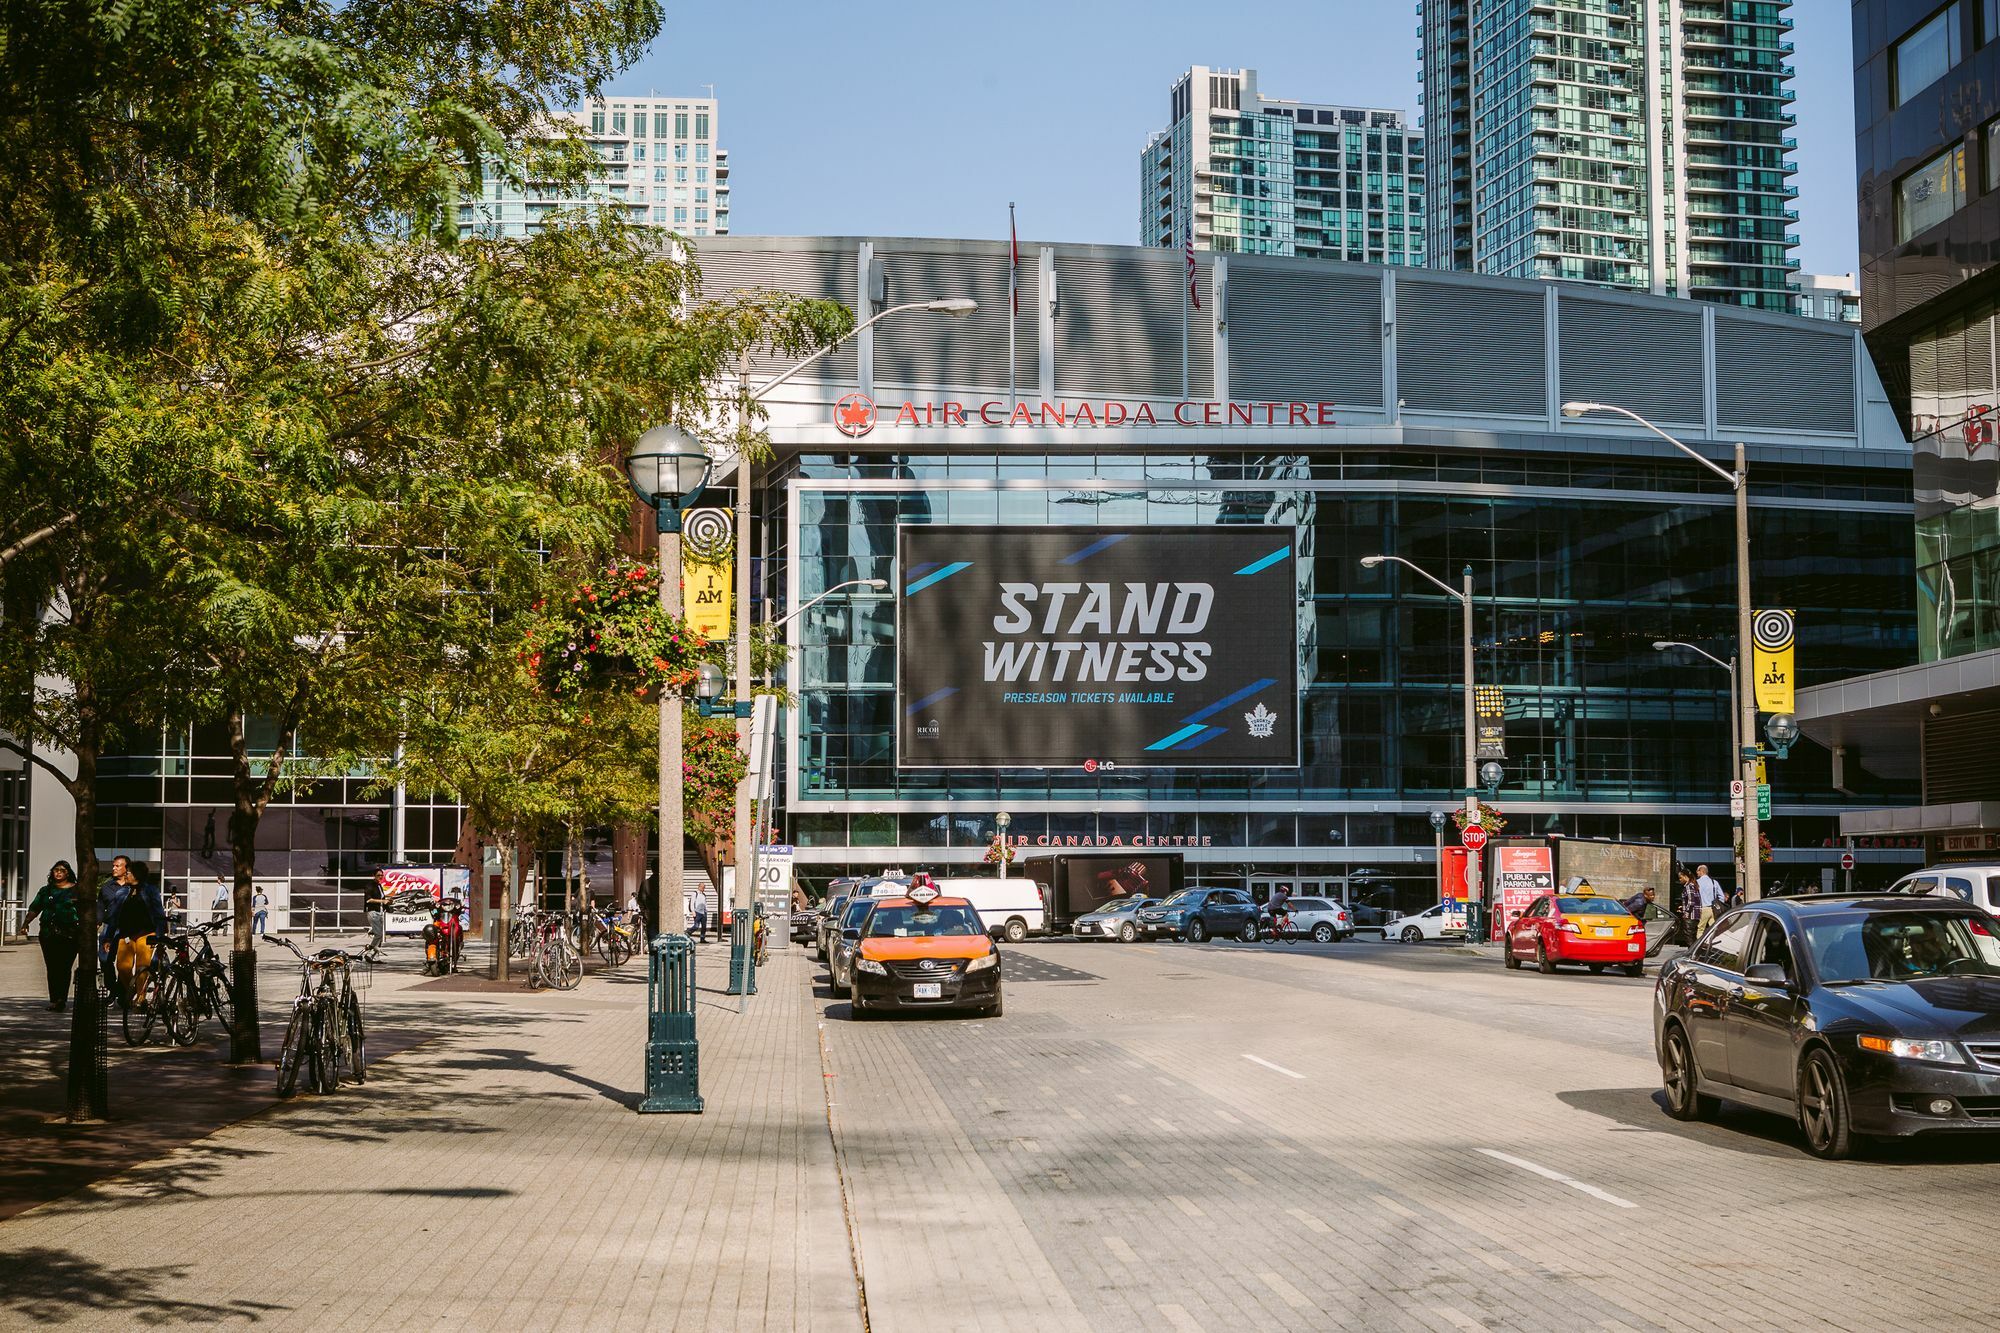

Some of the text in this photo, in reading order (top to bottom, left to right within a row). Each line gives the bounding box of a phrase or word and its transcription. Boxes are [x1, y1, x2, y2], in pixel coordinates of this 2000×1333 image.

[896, 401, 1337, 426] AIR CANADA CENTRE
[707, 575, 714, 588] I
[695, 590, 722, 604] AM
[993, 582, 1215, 634] STAND
[982, 641, 1213, 682] WITNESS
[1771, 661, 1777, 672] I
[1762, 673, 1785, 684] AM
[1003, 692, 1175, 703] PRESEASON TICKETS AVAILABLE
[1099, 761, 1115, 771] LG
[1037, 835, 1123, 846] CANADA
[1132, 835, 1212, 846] CENTRE
[1464, 832, 1485, 843] STOP
[381, 870, 437, 895] Ford
[1504, 880, 1536, 888] PARKING
